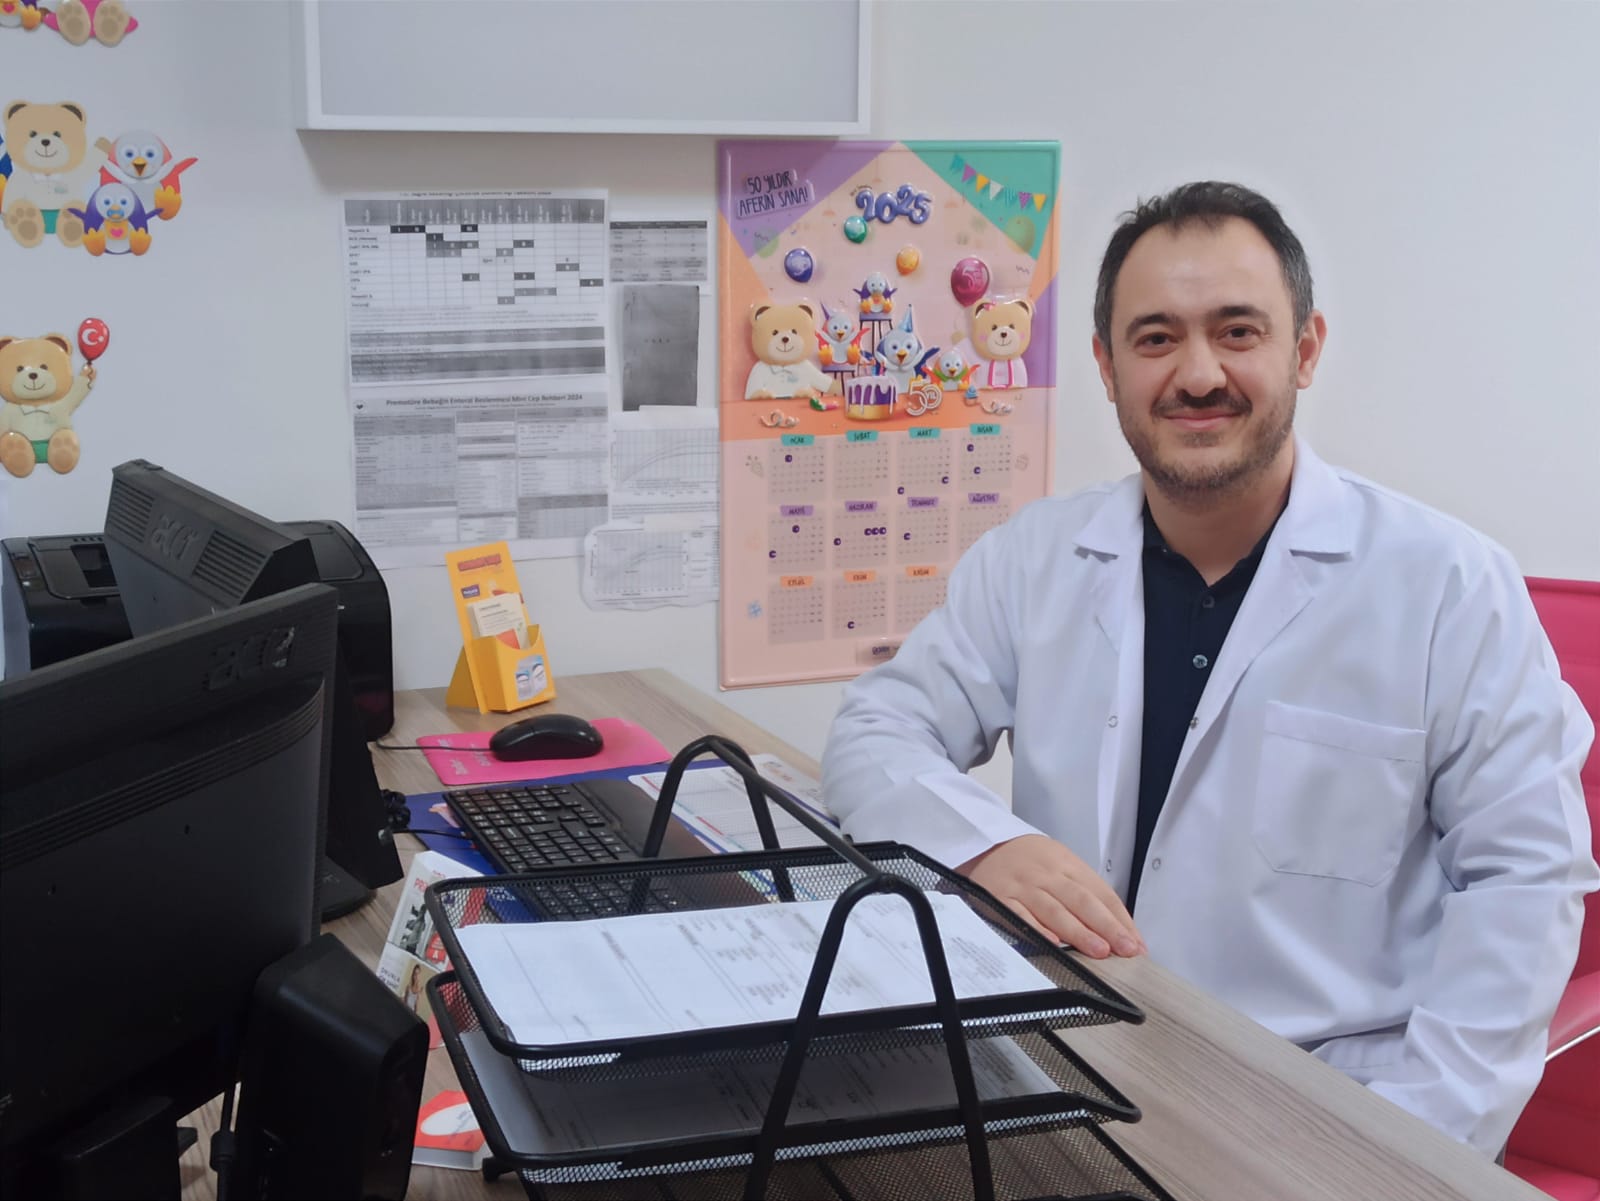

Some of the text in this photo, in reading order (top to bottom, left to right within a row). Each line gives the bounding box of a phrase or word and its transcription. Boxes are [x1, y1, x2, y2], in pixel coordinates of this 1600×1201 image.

[747, 171, 792, 194] 50 YILDIR
[778, 186, 808, 207] SANA!
[855, 184, 932, 224] 2025
